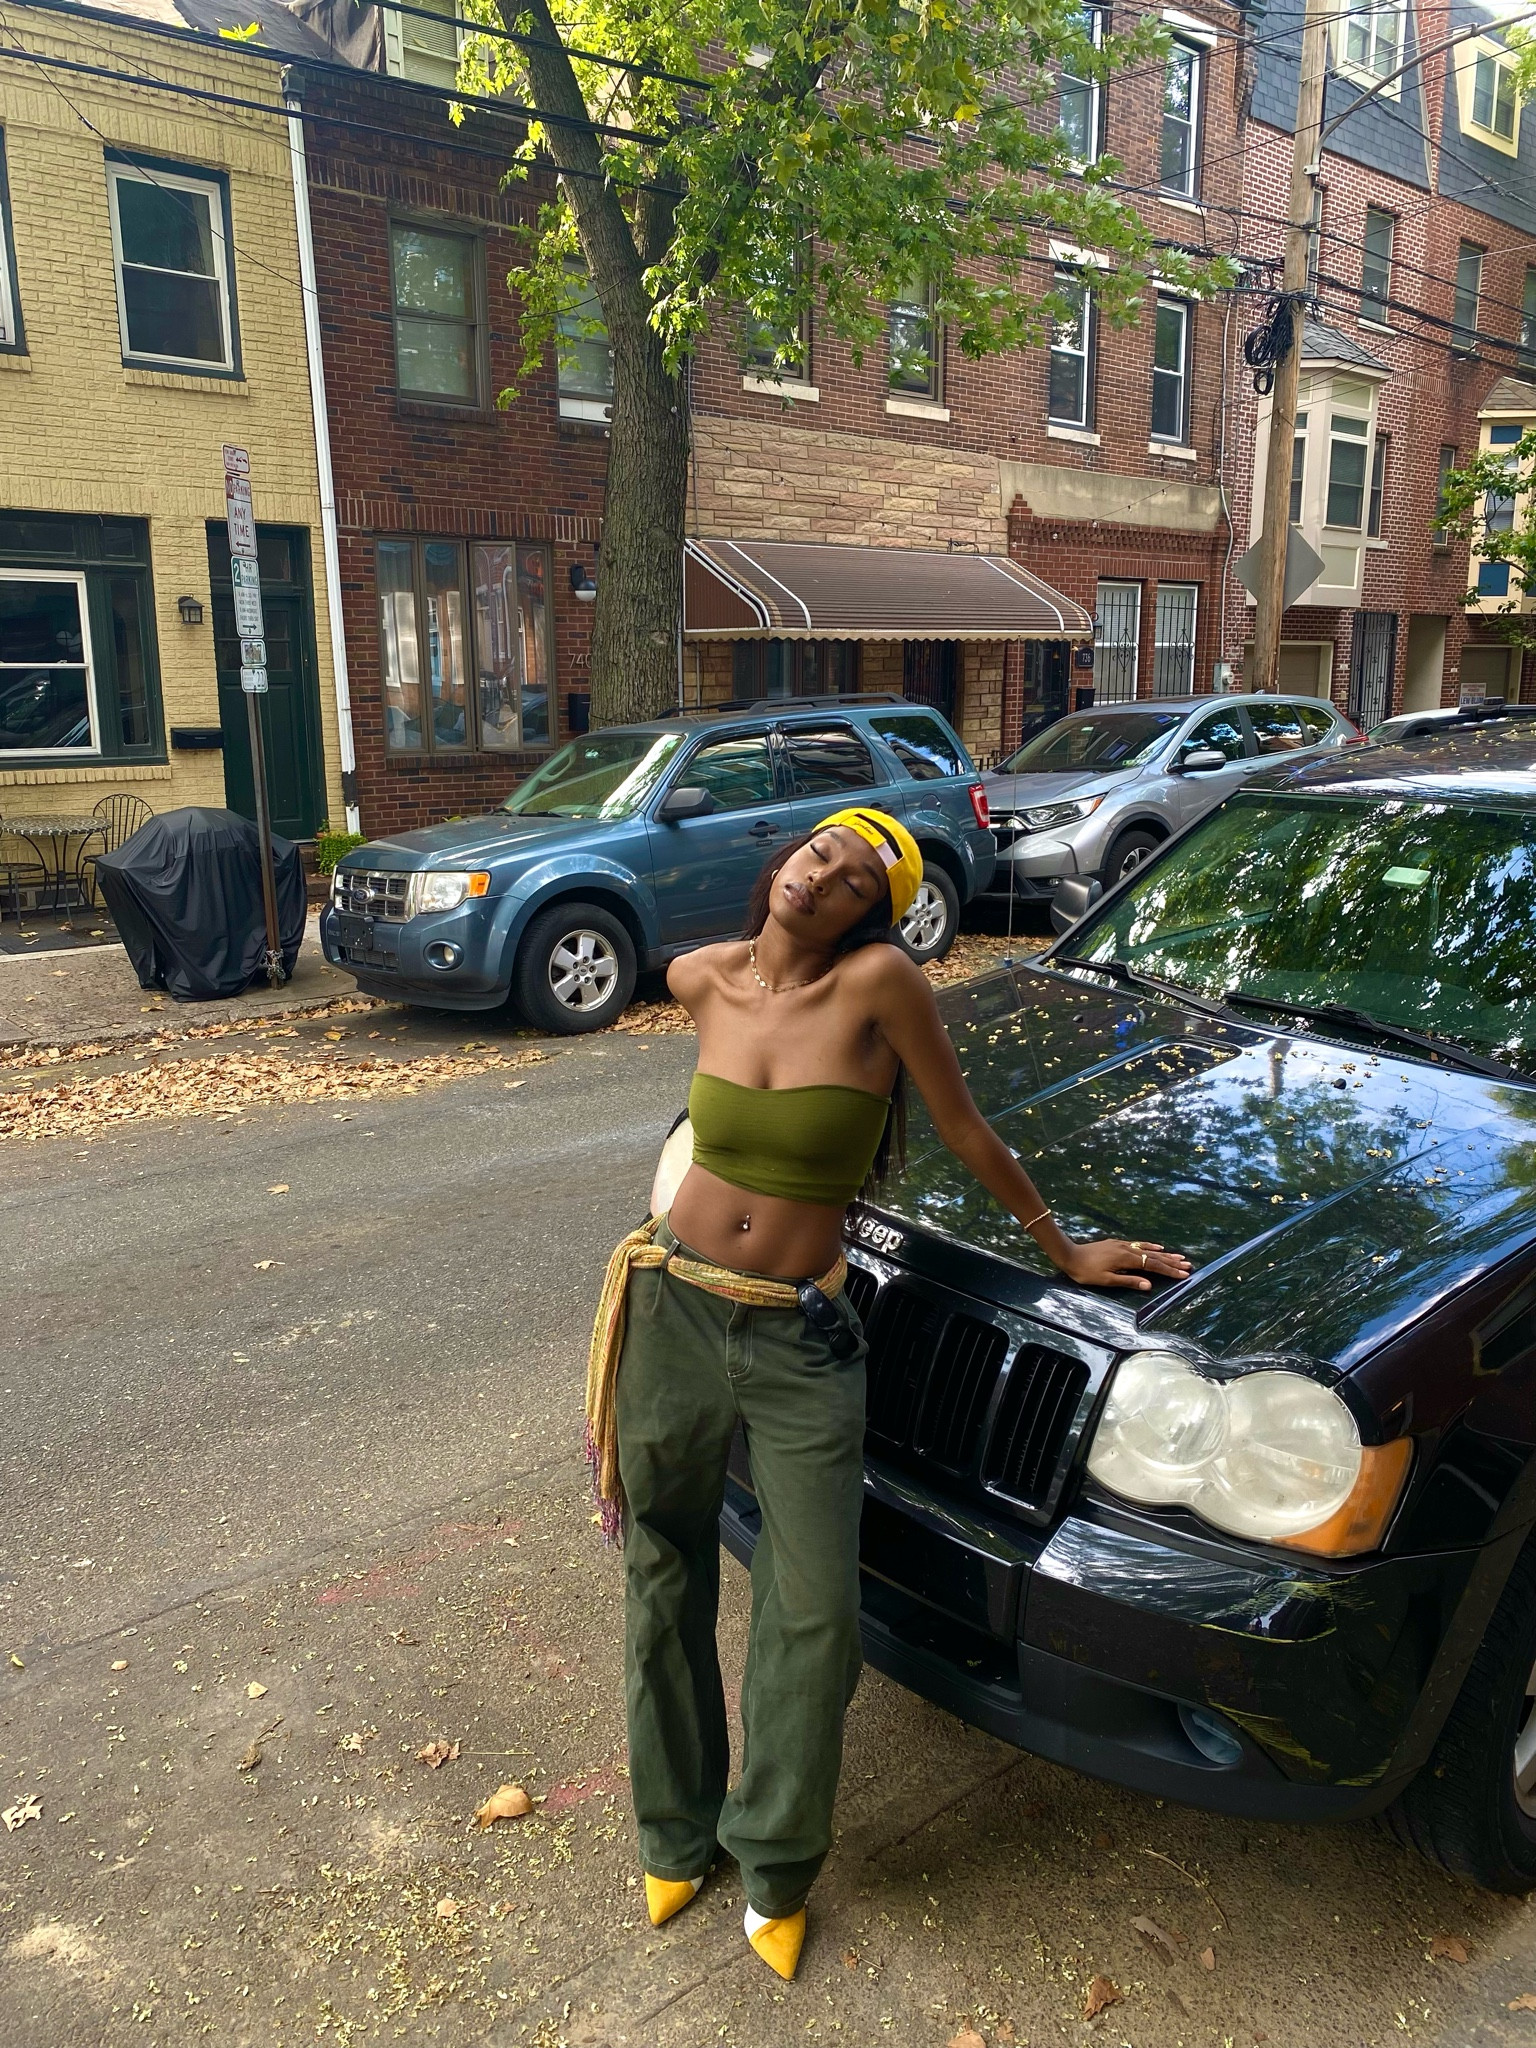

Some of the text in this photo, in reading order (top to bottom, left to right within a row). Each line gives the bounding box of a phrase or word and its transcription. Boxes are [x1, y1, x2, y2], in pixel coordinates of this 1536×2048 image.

[233, 484, 250, 497] PARKING
[234, 506, 246, 520] ANY
[234, 523, 249, 538] TIME
[233, 562, 241, 583] 2
[241, 574, 258, 586] PARKING
[568, 653, 592, 669] 740
[844, 1213, 904, 1254] Jeep
